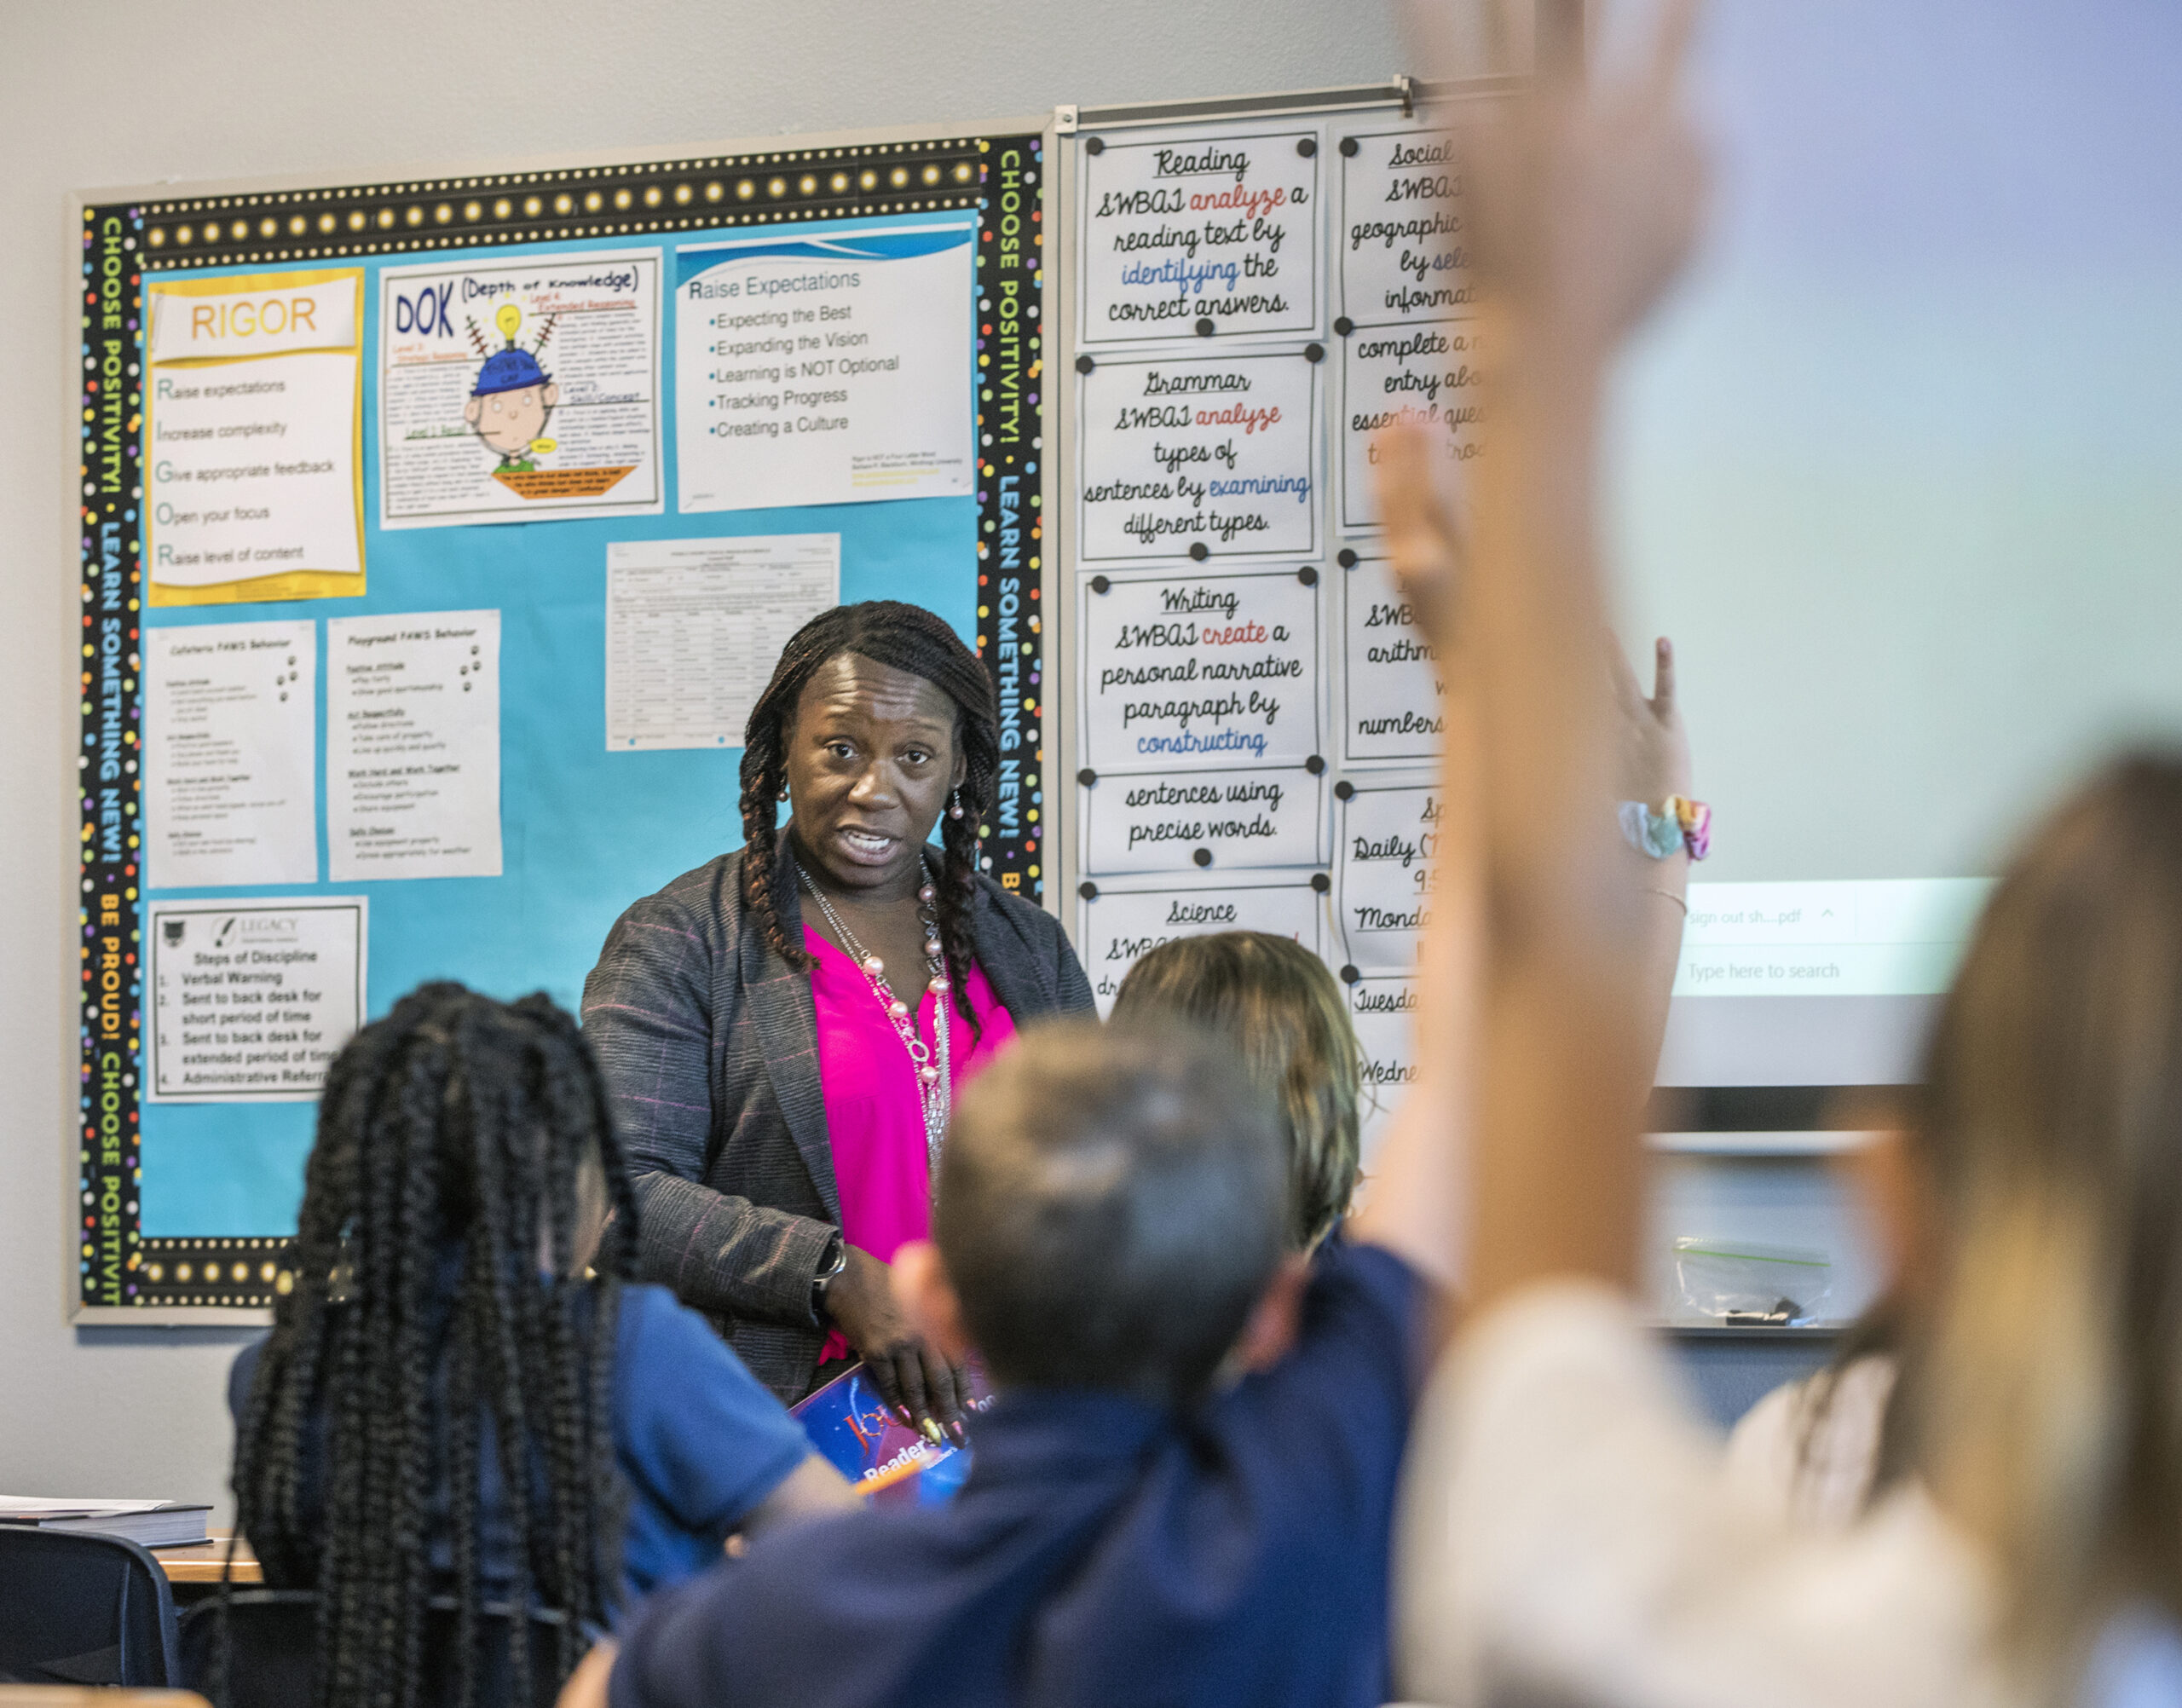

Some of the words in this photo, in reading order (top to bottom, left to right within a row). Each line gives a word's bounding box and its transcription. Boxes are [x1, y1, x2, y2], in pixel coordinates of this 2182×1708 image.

[1153, 147, 1250, 182] Reading
[1388, 140, 1454, 165] Social
[1001, 150, 1020, 268] CHOOSE
[1190, 184, 1286, 220] analyze
[1290, 187, 1308, 205] a
[1114, 224, 1202, 258] reading
[1204, 220, 1250, 245] text
[1252, 217, 1285, 253] by
[1351, 211, 1464, 250] geographic
[102, 217, 123, 331] CHOOSE
[1122, 258, 1241, 294] identifying
[1244, 253, 1279, 278] the
[1400, 250, 1430, 282] by
[461, 277, 516, 303] (Depth
[547, 265, 639, 292] Knowledge)
[689, 281, 741, 299] Raise
[746, 272, 861, 298] Expectations
[192, 297, 317, 340] RIGOR
[395, 280, 454, 338] DOK
[717, 310, 788, 331] Expecting
[792, 308, 816, 324] the
[819, 305, 851, 322] Best
[1109, 292, 1191, 321] correct
[1194, 294, 1290, 316] answers.
[717, 337, 794, 357] Expanding
[798, 335, 820, 350] the
[825, 332, 869, 349] Vision
[1358, 332, 1450, 365] complete
[1452, 336, 1469, 351] a
[717, 365, 780, 384] Learning
[784, 363, 797, 378] is
[801, 361, 834, 378] NOT
[839, 355, 900, 377] Optional
[999, 280, 1020, 443] POSITIVITY!
[158, 379, 202, 401] Raise
[203, 379, 286, 399] expectations
[1143, 371, 1251, 395] Grammar
[1384, 369, 1441, 401] entry
[717, 391, 778, 411] Tracking
[783, 389, 847, 409] Progress
[101, 340, 123, 494] POSITIVITY!
[157, 421, 214, 441] Increase
[216, 422, 287, 441] complexity
[717, 419, 779, 439] Creating
[783, 421, 794, 434] a
[797, 416, 849, 434] Culture
[1195, 402, 1282, 436] analyze
[1352, 403, 1440, 431] essential
[155, 461, 193, 483] Give
[196, 463, 270, 485] appropriate
[274, 459, 335, 477] feedback
[1154, 441, 1212, 474] types
[1215, 438, 1238, 470] of
[1083, 479, 1173, 502] sentences
[1177, 476, 1205, 508] by
[1209, 474, 1311, 504] examining
[156, 503, 200, 526] Open
[203, 508, 234, 523] your
[237, 505, 269, 519] focus
[999, 476, 1020, 569] LEARN
[1123, 511, 1207, 544] different
[1209, 511, 1270, 542] types.
[101, 522, 122, 611] LEARN
[158, 545, 201, 566] Raise
[204, 550, 234, 563] level
[236, 548, 251, 563] of
[254, 545, 304, 562] content
[1160, 587, 1240, 620] Writing
[1202, 620, 1269, 646] create
[1273, 625, 1290, 642] a
[998, 578, 1020, 752] SOMETHING
[1100, 658, 1199, 695] personal
[1202, 655, 1303, 681] narrative
[101, 618, 122, 781] SOMETHING
[1123, 691, 1244, 730] paragraph
[1249, 690, 1280, 725] by
[1137, 727, 1268, 759] constructing
[998, 759, 1020, 839] NEW!
[1125, 782, 1222, 806] sentences
[1226, 781, 1284, 811] using
[101, 788, 122, 864] NEW!
[1129, 820, 1204, 851] precise
[1208, 813, 1278, 840] words.
[1354, 835, 1416, 868] Daily
[101, 893, 120, 926] BE
[1166, 901, 1238, 924] Science
[1688, 911, 1717, 927] sign
[1720, 911, 1745, 924] out
[194, 952, 230, 967] Steps
[234, 952, 249, 963] of
[252, 950, 318, 967] Discipline
[1688, 963, 1724, 984] Type
[1729, 963, 1763, 979] here
[1768, 964, 1785, 979] to
[1789, 962, 1841, 979] search
[101, 936, 121, 1041] PROUD!
[182, 972, 226, 985] Verbal
[228, 972, 283, 987] Warning
[182, 993, 211, 1006] Sent
[215, 992, 228, 1005] to
[233, 991, 263, 1004] back
[268, 990, 297, 1003] desk
[303, 990, 321, 1002] for
[182, 1012, 216, 1024] short
[219, 1012, 263, 1026] period
[266, 1011, 280, 1023] of
[282, 1010, 311, 1022] time
[182, 1032, 211, 1045] Sent
[215, 1032, 228, 1044] to
[233, 1031, 263, 1043] back
[268, 1030, 297, 1043] desk
[303, 1030, 322, 1042] for
[182, 1052, 243, 1065] extended
[245, 1051, 288, 1065] period
[292, 1050, 307, 1062] of
[183, 1070, 278, 1084] Administrative
[101, 1051, 121, 1166] CHOOSE
